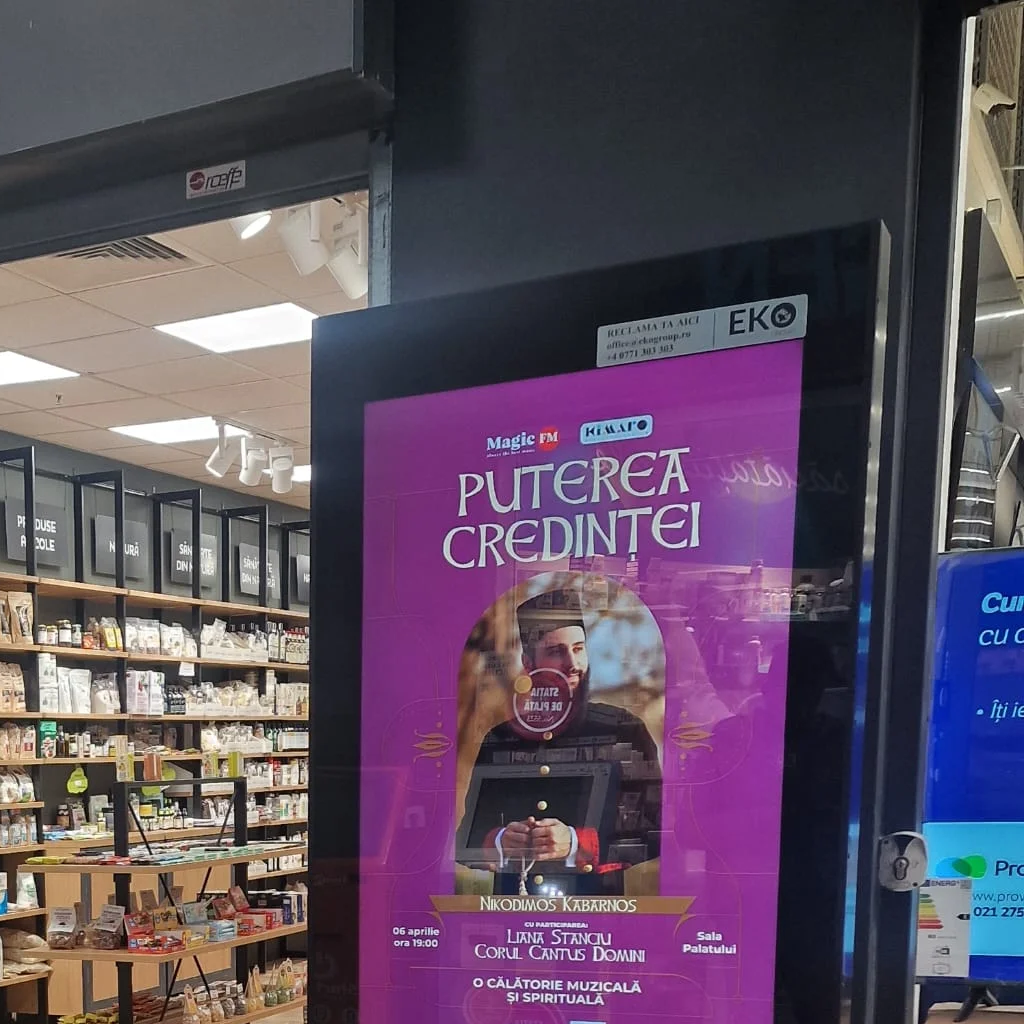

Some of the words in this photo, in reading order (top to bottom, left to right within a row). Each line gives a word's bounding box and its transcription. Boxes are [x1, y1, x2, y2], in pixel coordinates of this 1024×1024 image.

[729, 302, 797, 336] EKO
[607, 323, 658, 338] RECLAMA
[486, 432, 535, 451] Magic
[539, 431, 558, 444] FM
[458, 446, 690, 517] PUTEREA
[17, 515, 56, 533] PRDUSE
[20, 535, 55, 551] ACOLE
[442, 502, 701, 569] CREDINȚEI
[109, 541, 139, 557] NURĂ
[979, 629, 1009, 646] cu
[480, 896, 556, 912] NIKODIMOS
[562, 896, 637, 913] KABARNOS
[974, 907, 997, 917] 021
[1001, 907, 1024, 918] 275
[392, 926, 406, 936] 06
[407, 926, 440, 937] aprilie
[507, 929, 544, 944] LIANA
[551, 929, 612, 946] STANCIU
[696, 931, 723, 941] Sala
[412, 939, 438, 948] 19:00
[682, 943, 737, 954] Palatului
[474, 944, 523, 960] CORUL
[528, 944, 586, 962] CANTUS
[592, 945, 646, 963] DOMINI
[472, 978, 484, 988] O
[486, 976, 564, 991] CĂLĂTORIE
[567, 980, 642, 994] MUZICALĂ
[506, 992, 519, 1005] ȘI
[523, 993, 605, 1006] SPIRITUALĂ
